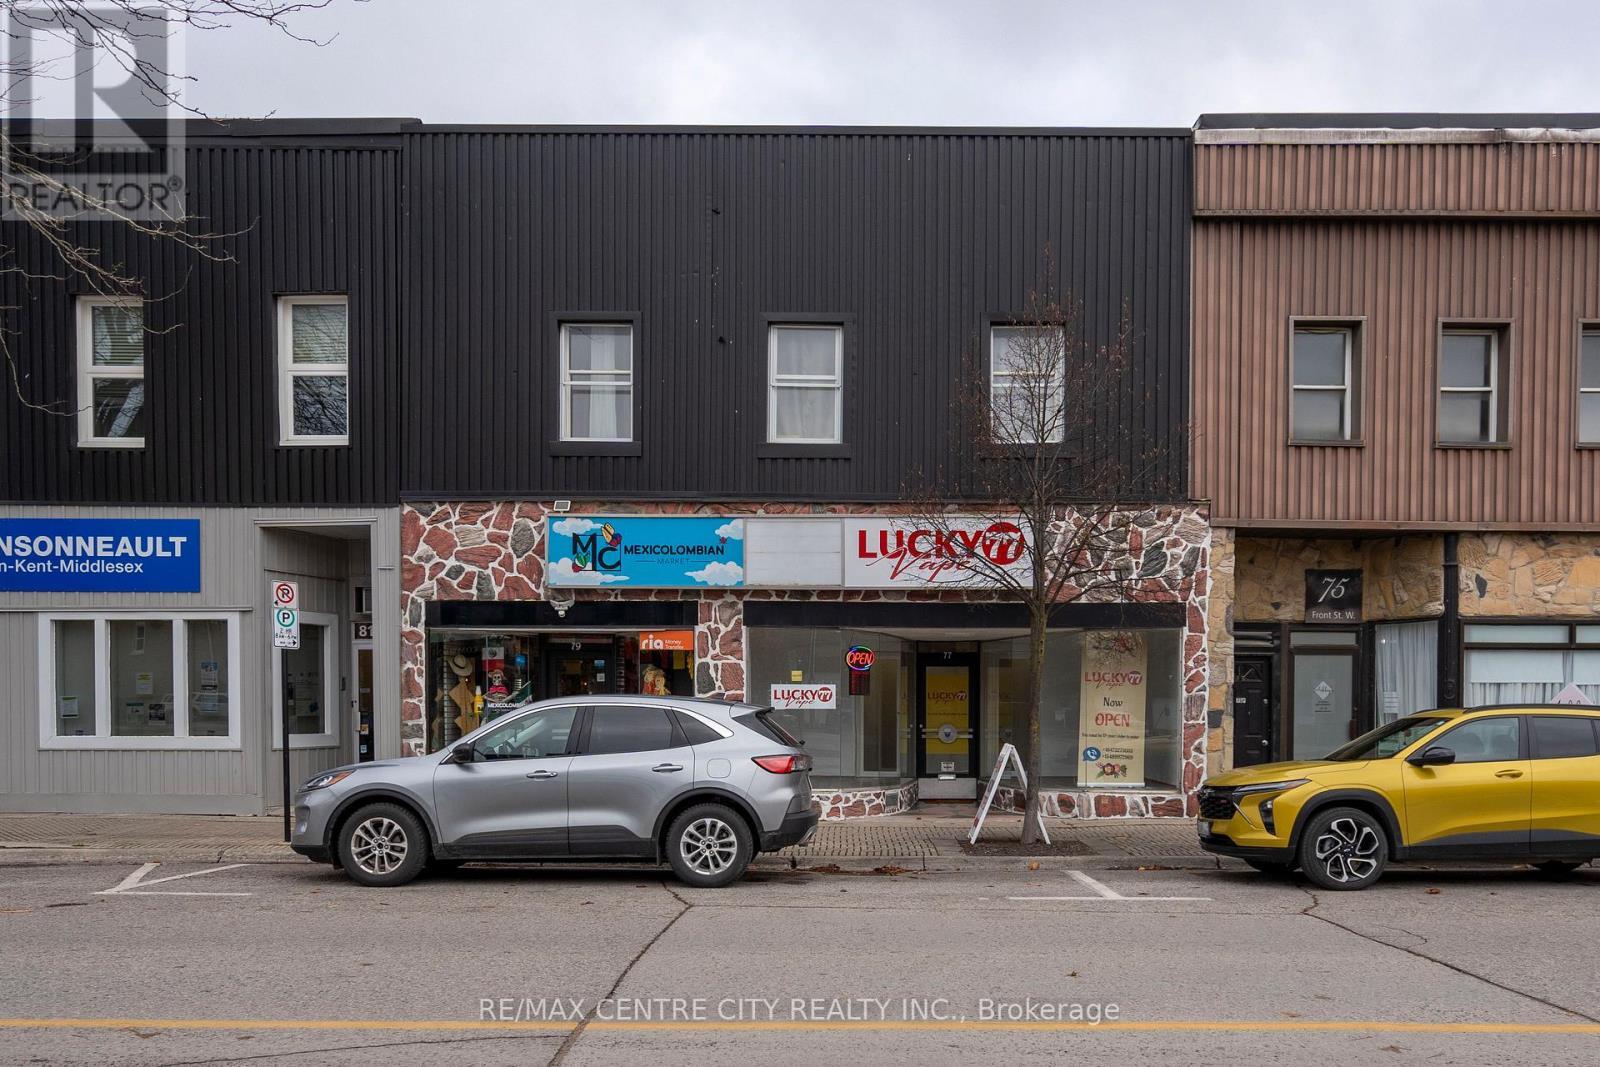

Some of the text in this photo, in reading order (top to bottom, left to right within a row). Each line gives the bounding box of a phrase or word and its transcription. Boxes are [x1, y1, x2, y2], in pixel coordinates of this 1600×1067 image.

[0, 536, 187, 557] NSONNEAULT
[624, 545, 724, 555] MEXICOLOMBIAN
[0, 560, 144, 573] n-Kent-Middlesex
[1318, 577, 1350, 602] 75
[1311, 611, 1356, 619] Front St. W.
[570, 642, 581, 651] 79
[641, 634, 664, 650] ria
[849, 652, 872, 665] OPEN
[943, 651, 952, 659] 77
[1103, 697, 1123, 707] Now
[1095, 713, 1130, 727] OPEN
